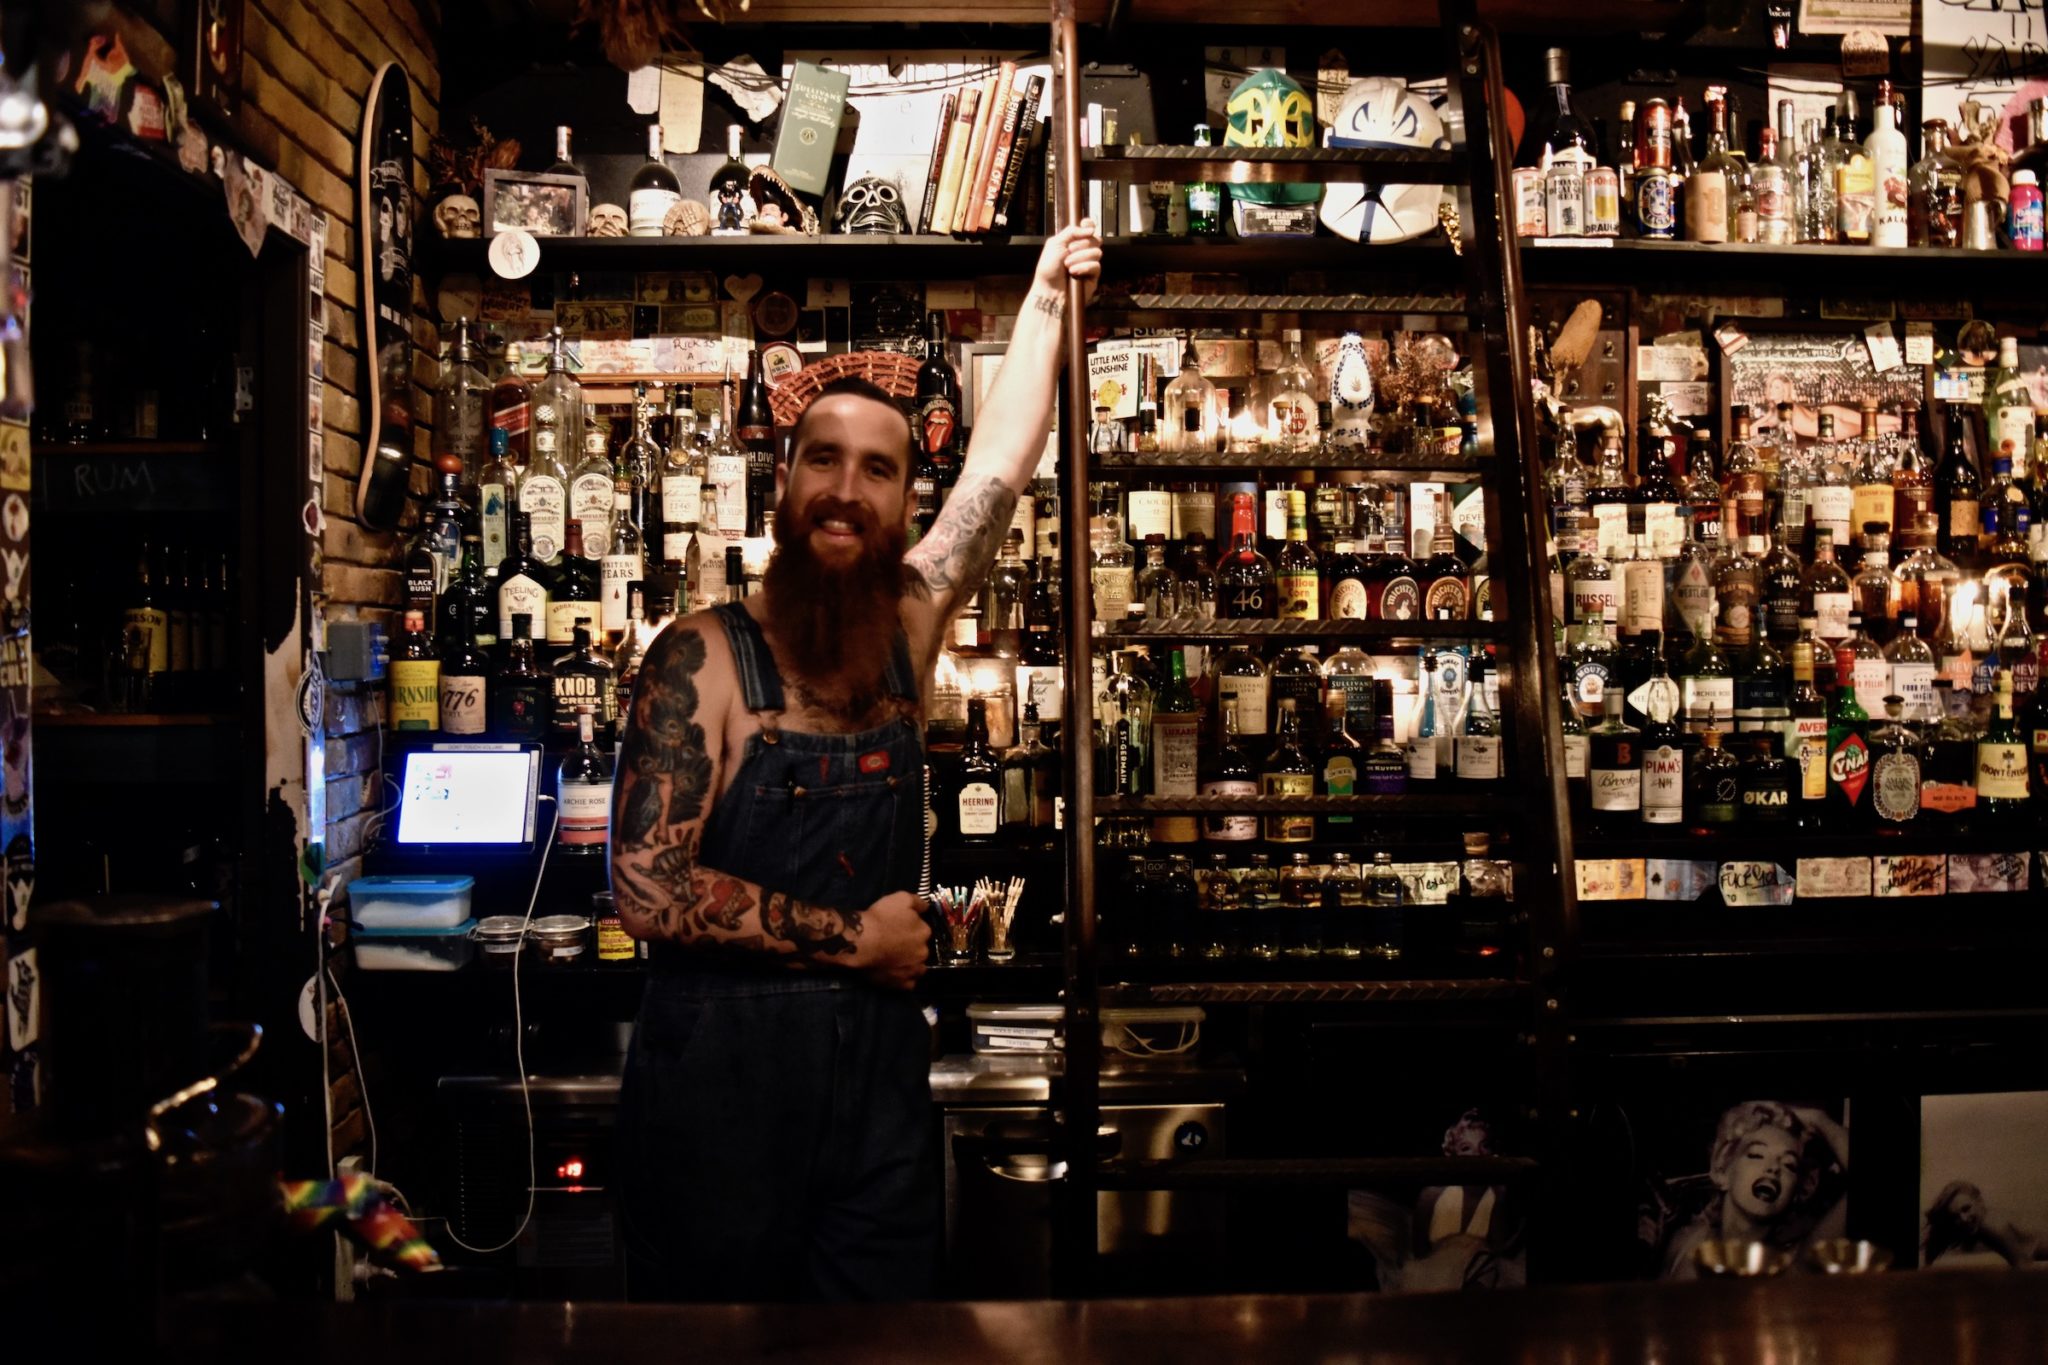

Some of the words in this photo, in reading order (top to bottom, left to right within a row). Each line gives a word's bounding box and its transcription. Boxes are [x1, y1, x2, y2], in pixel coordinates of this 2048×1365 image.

[1089, 356, 1108, 366] LITTLE
[1110, 353, 1127, 363] MISS
[1090, 363, 1127, 376] SUNSHINE
[757, 452, 773, 464] DIVE
[73, 461, 155, 496] RUM
[504, 587, 539, 598] TEELING
[1231, 588, 1262, 612] 46
[554, 677, 595, 696] KNOB
[558, 697, 601, 705] CREEK
[1645, 759, 1681, 774] PIMM'S
[962, 798, 994, 806] HEERING
